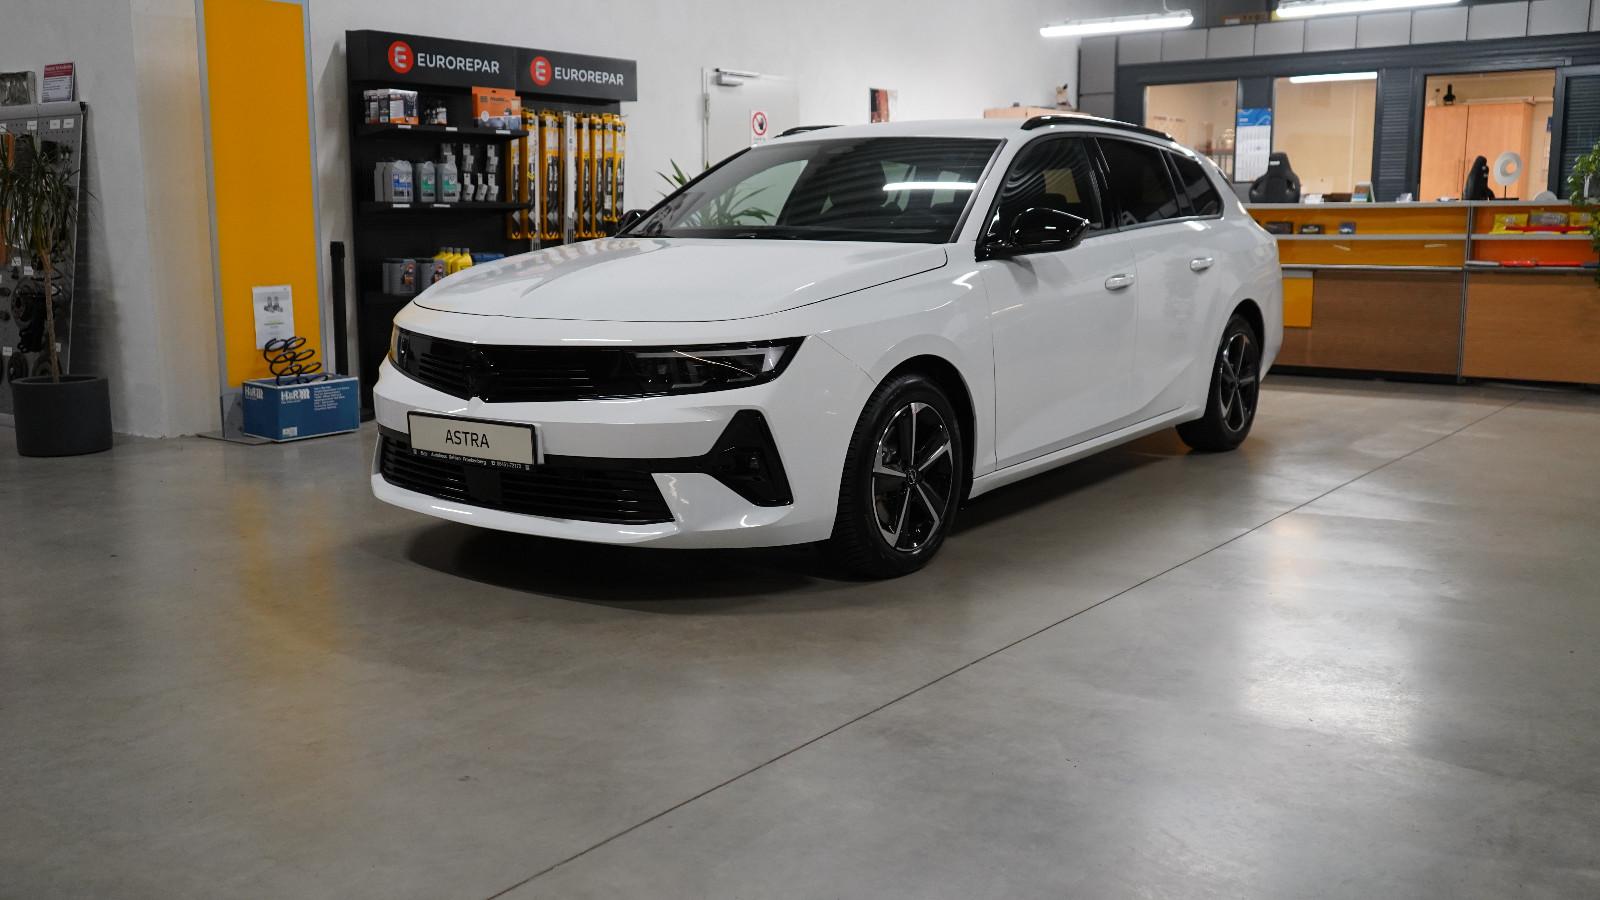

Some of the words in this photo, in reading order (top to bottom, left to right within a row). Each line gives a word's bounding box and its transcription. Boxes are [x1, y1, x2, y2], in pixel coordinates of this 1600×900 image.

[417, 52, 500, 74] EUROREPAR
[554, 66, 624, 86] EUROREPAR
[445, 429, 490, 448] ASTRA
